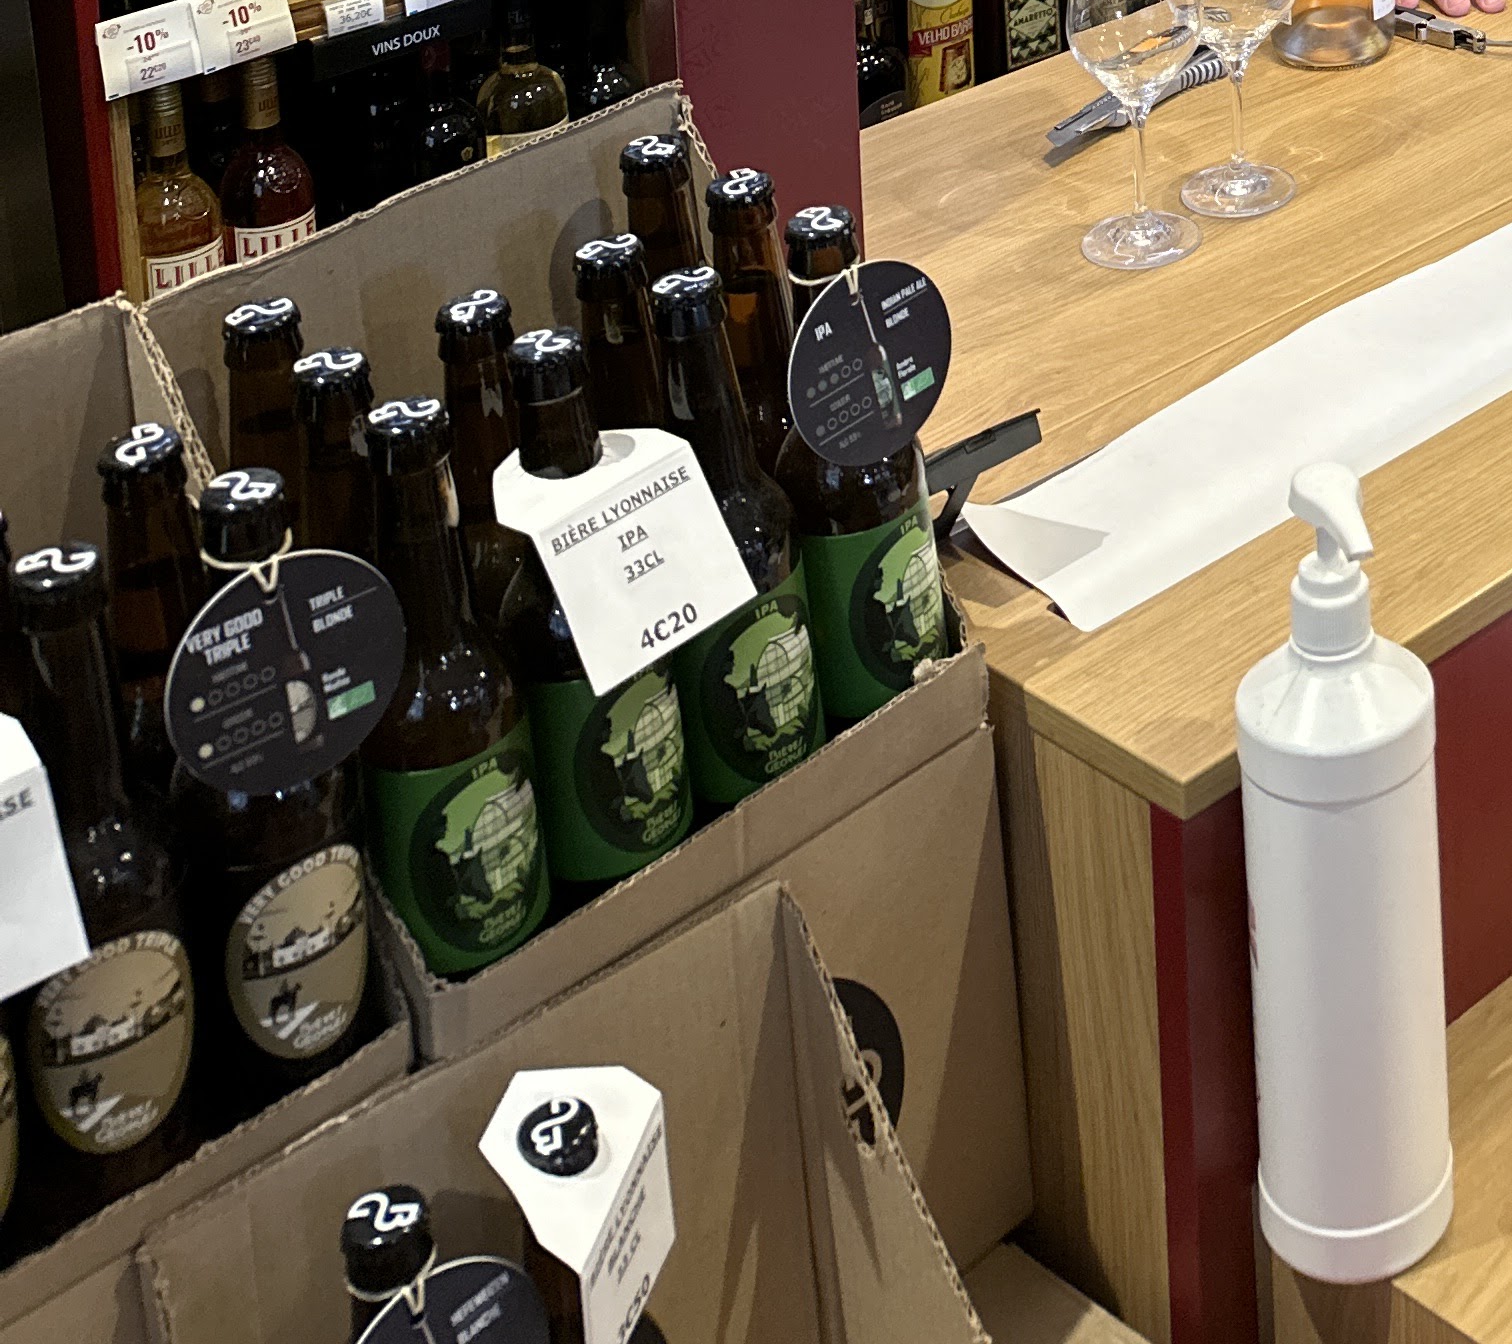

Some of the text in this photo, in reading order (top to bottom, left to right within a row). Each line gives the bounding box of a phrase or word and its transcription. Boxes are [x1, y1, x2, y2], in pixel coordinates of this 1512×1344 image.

[222, 1, 263, 28] -10%
[339, 7, 373, 26] 36,20€
[1013, 7, 1053, 26] AMARETTO
[126, 27, 170, 53] -10%
[371, 25, 441, 56] VINS DOUX
[880, 276, 927, 311] INDIAN PALE ALE
[814, 321, 833, 342] IPA
[551, 465, 692, 555] BIÈRE LYONNAISE
[617, 524, 649, 552] IPA
[900, 514, 918, 535] IPA
[623, 550, 665, 583] 33CL
[308, 585, 345, 611] TRIPLE
[755, 598, 780, 620] IPA
[184, 607, 264, 654] VERY GOOD
[312, 604, 354, 634] BLONDE
[640, 602, 698, 650] 4€20
[204, 632, 251, 666] TRIPLE
[471, 758, 500, 781] IPA
